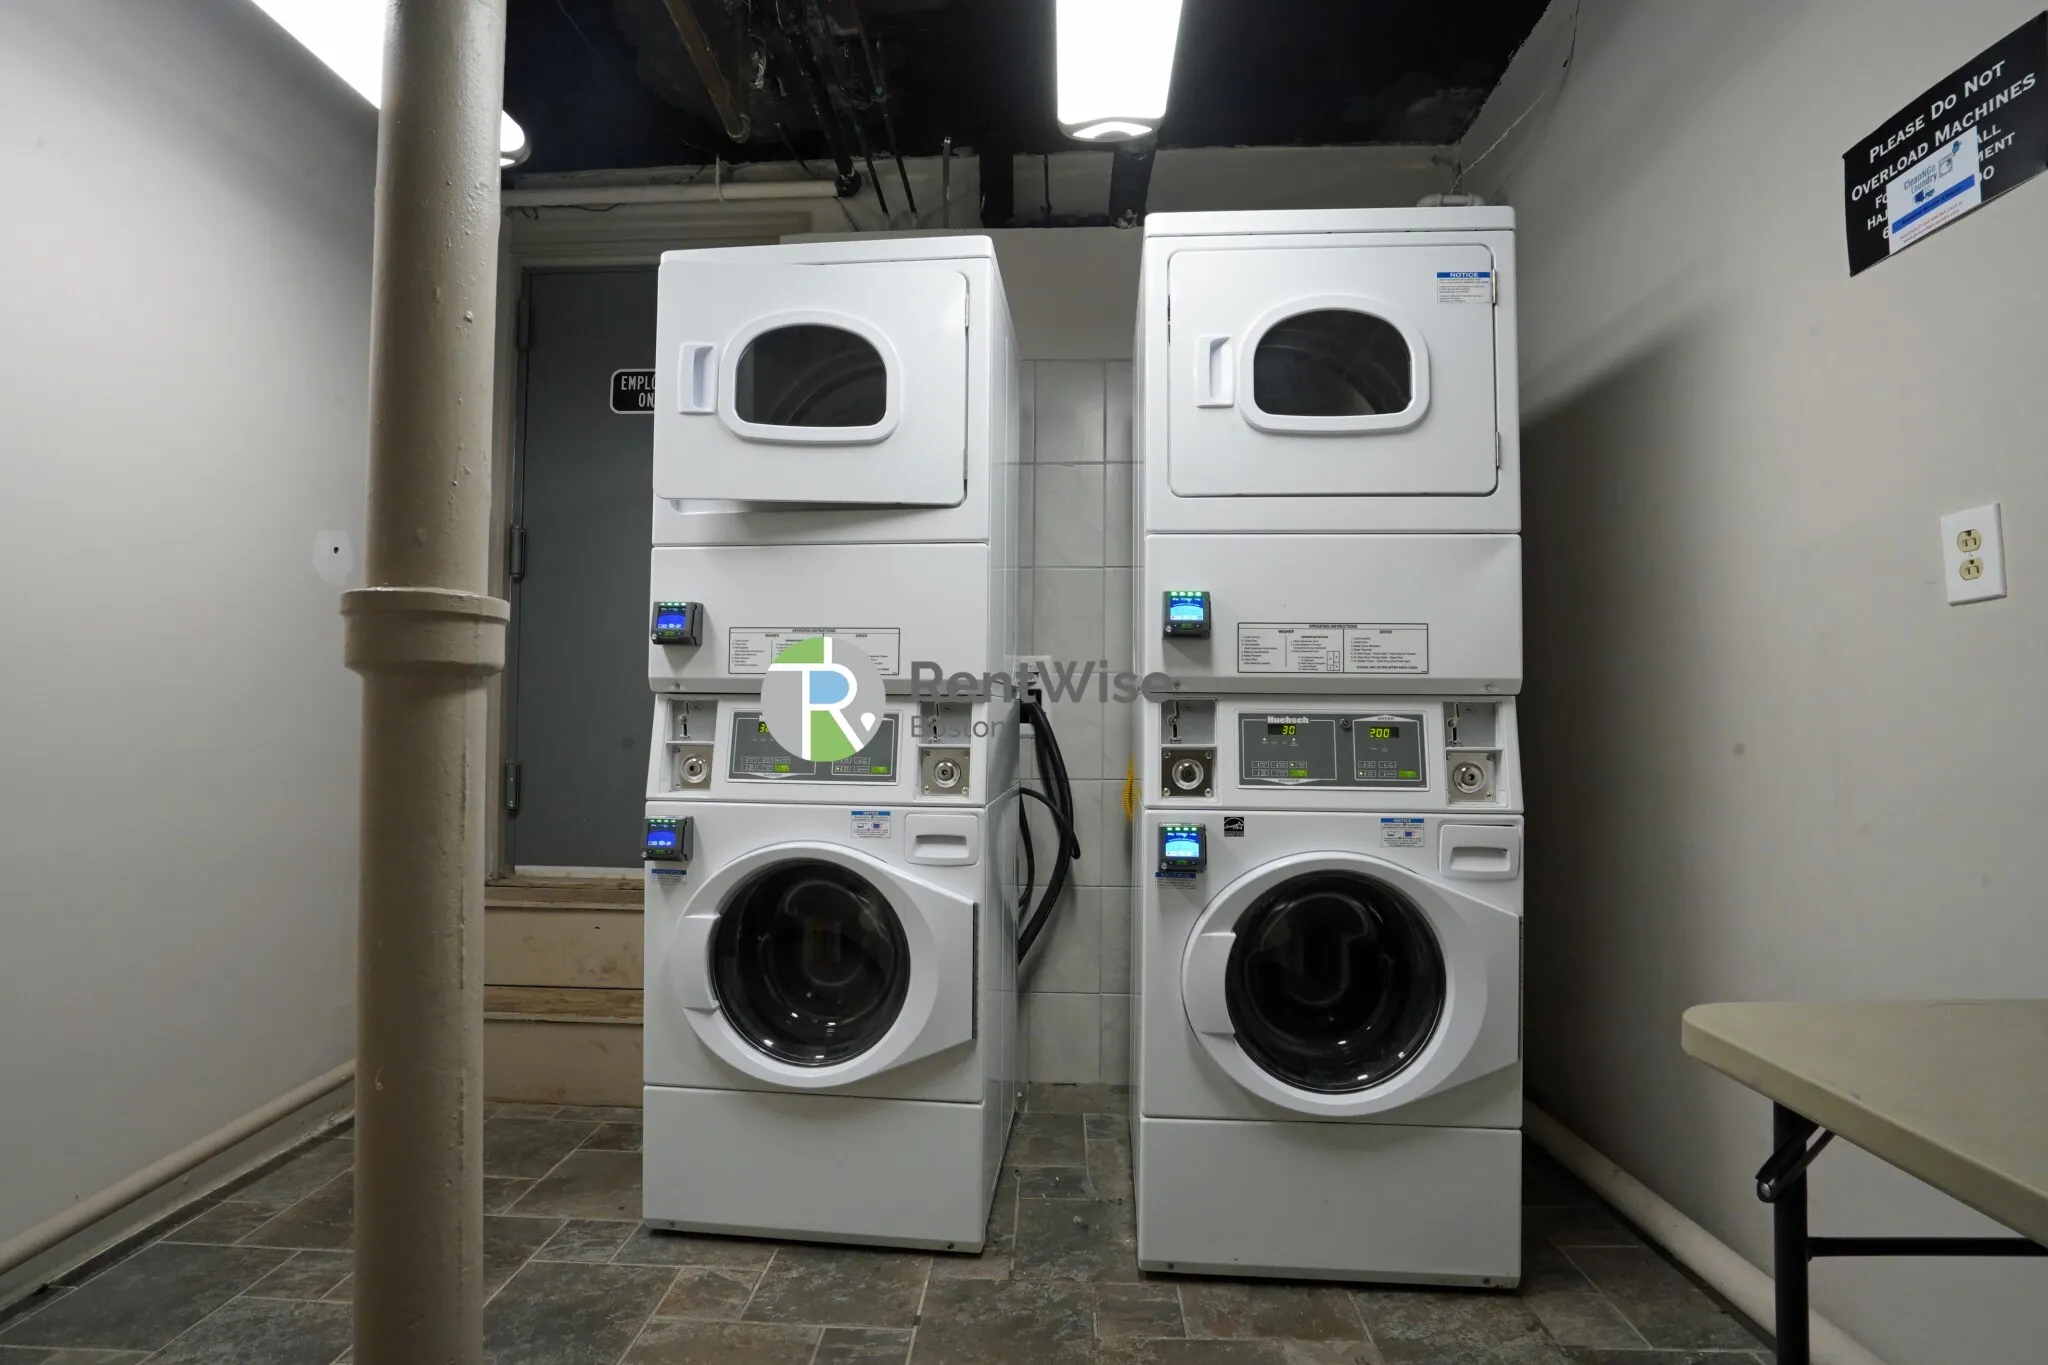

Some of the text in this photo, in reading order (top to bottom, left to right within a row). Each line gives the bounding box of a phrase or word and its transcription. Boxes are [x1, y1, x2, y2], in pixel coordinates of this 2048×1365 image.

[1869, 60, 2006, 164] PLEASE DO NOT
[1852, 73, 2036, 201] OVERLOAD MACHINES
[1267, 716, 1310, 724] Huebsch
[1282, 725, 1296, 735] 30
[1369, 728, 1390, 738] 200
